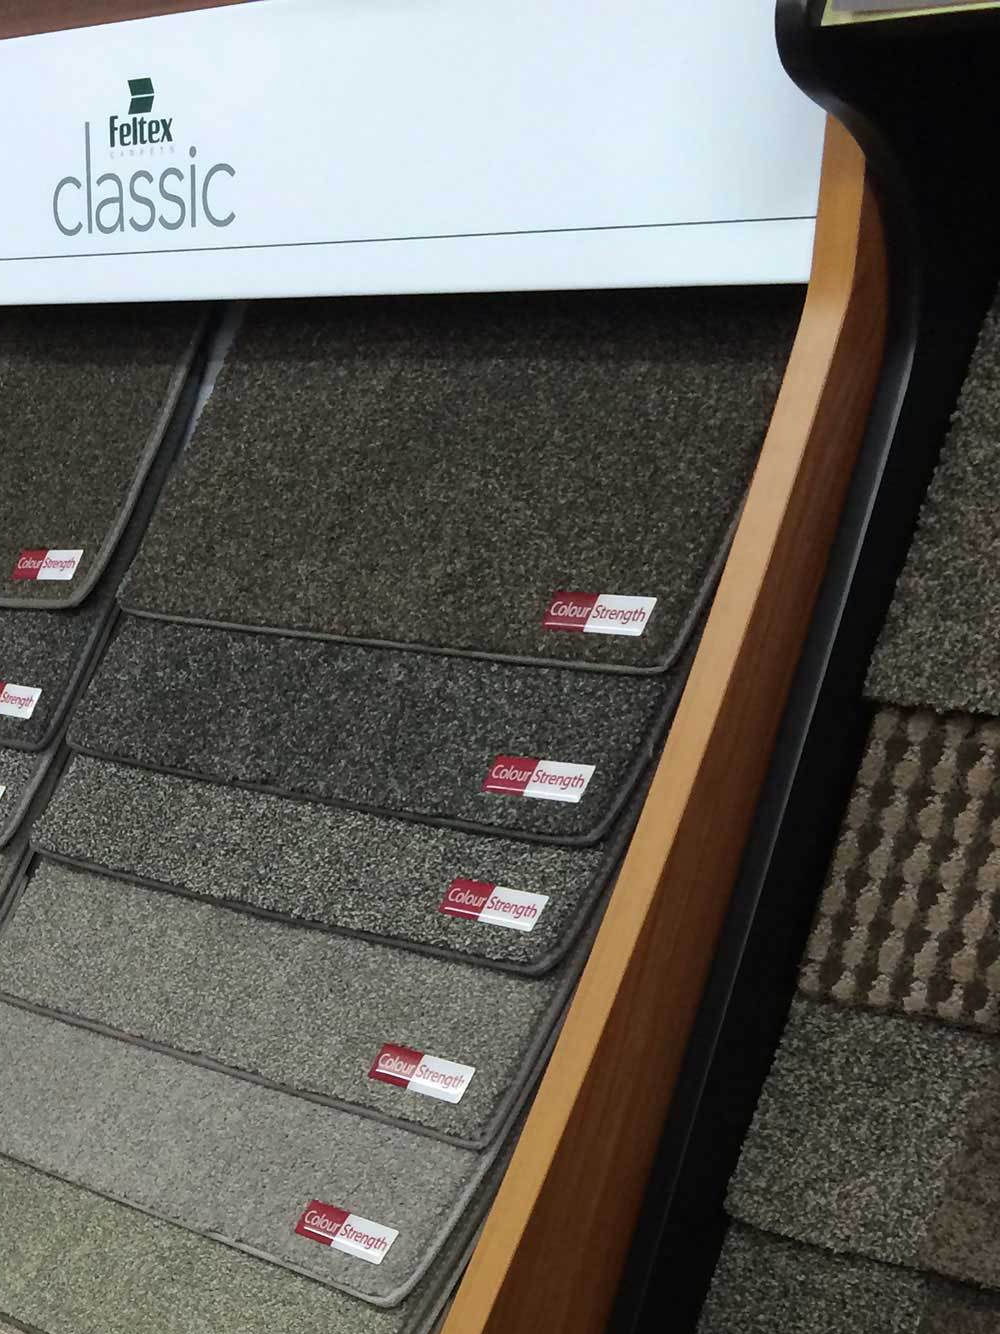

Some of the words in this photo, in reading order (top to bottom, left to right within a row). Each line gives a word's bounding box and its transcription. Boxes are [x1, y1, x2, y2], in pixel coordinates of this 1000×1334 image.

[109, 115, 173, 148] Feltex
[53, 121, 236, 236] classic
[17, 557, 43, 569] Colour
[42, 557, 76, 572] Strength
[550, 601, 593, 618] Colour
[592, 604, 646, 624] Strength
[1, 691, 34, 709] Strength
[491, 764, 532, 782] Colour
[532, 769, 585, 789] Strength
[447, 888, 487, 908] Colour
[486, 896, 538, 919] Strength
[377, 1052, 417, 1075] Colour
[415, 1064, 465, 1089] Strength
[304, 1210, 342, 1234] Colour
[340, 1224, 388, 1251] Strength
